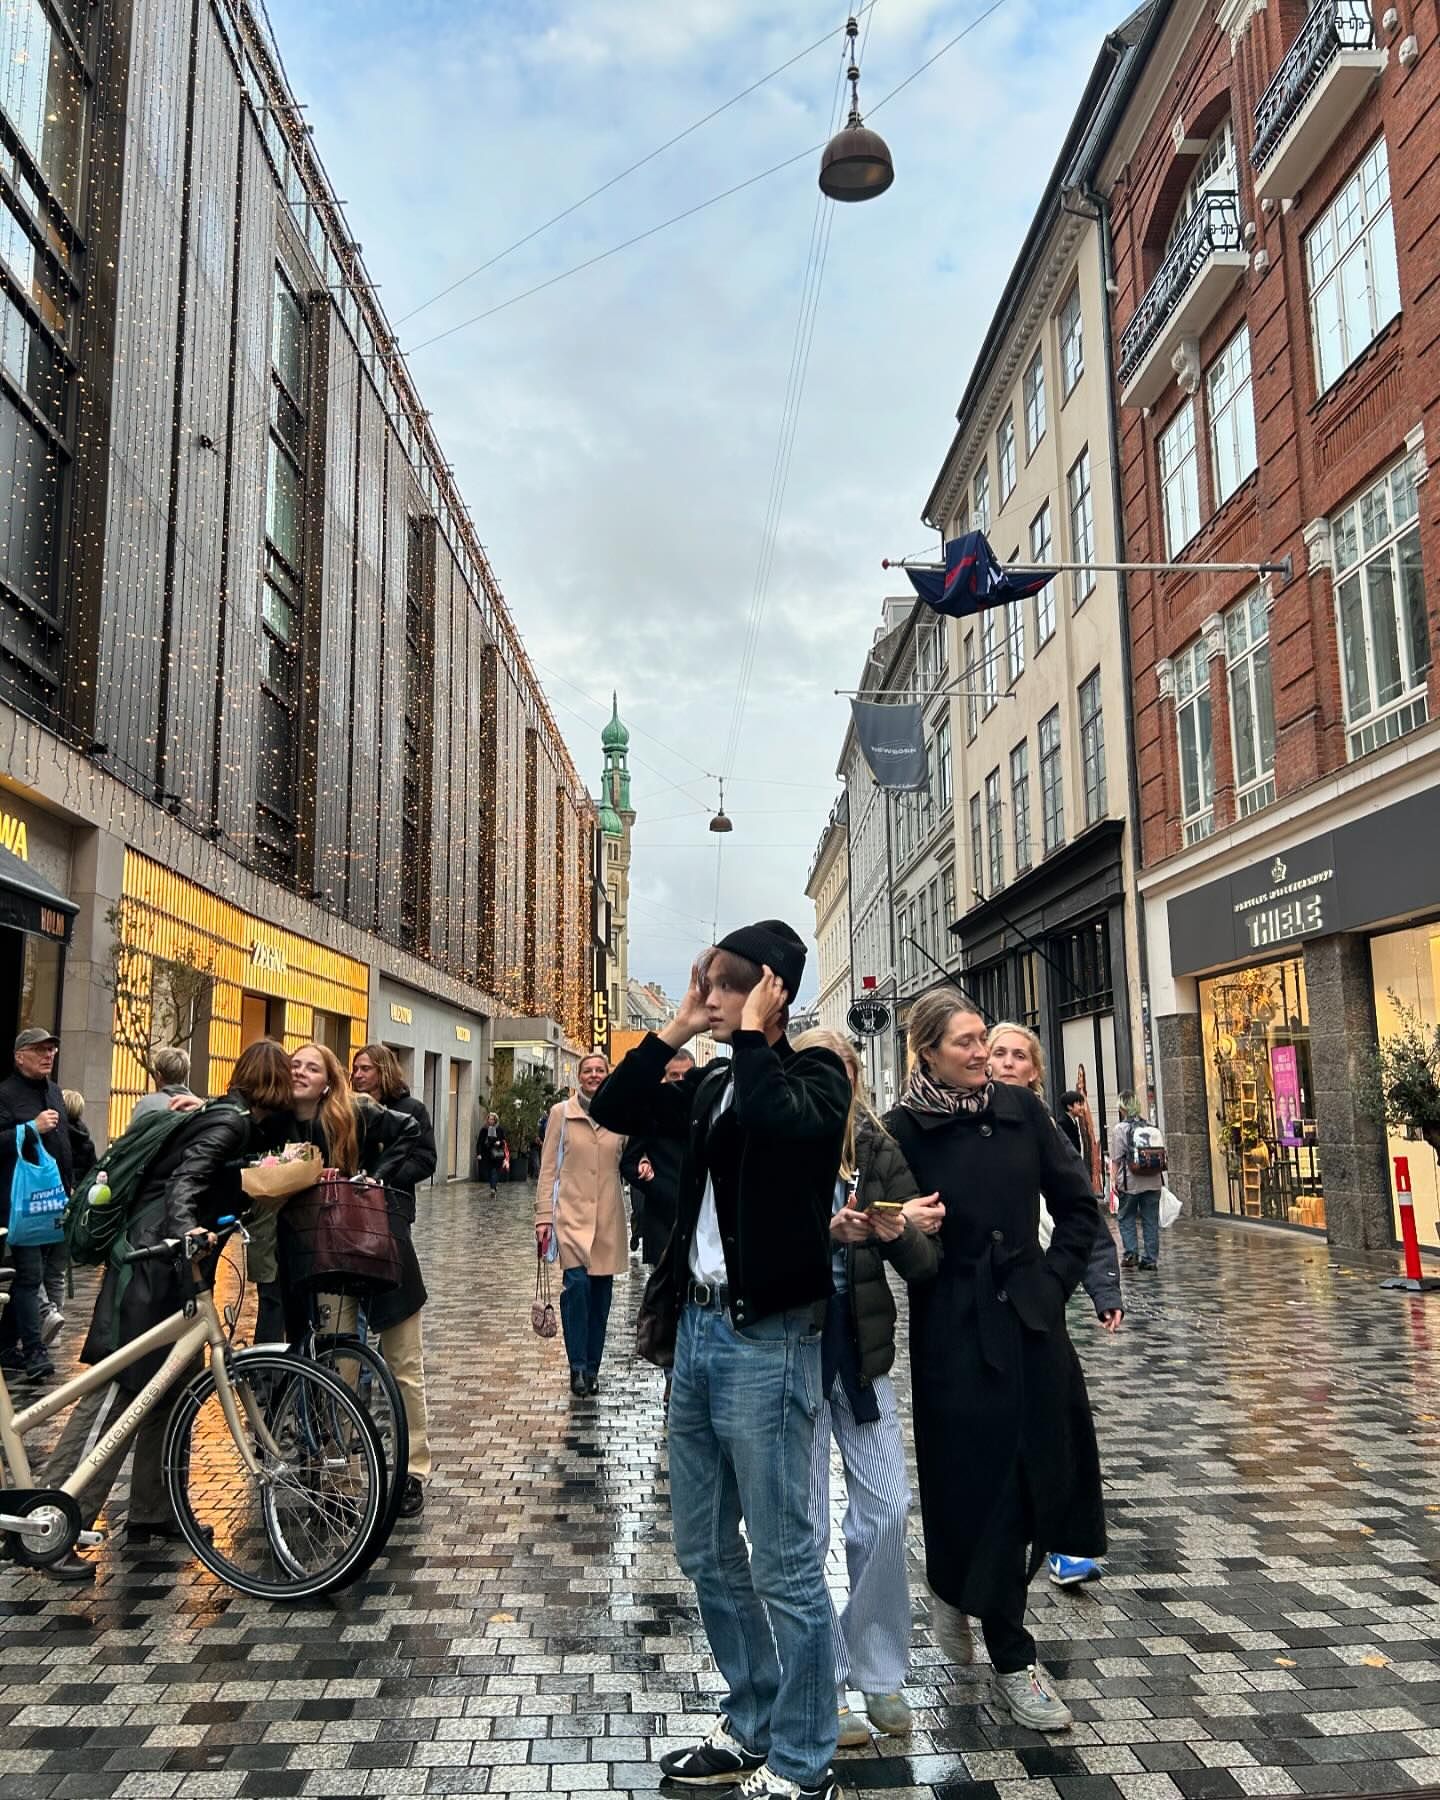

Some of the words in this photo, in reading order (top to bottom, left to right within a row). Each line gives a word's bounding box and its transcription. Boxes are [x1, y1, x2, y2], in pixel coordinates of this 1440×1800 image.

[1246, 894, 1323, 948] THIELE
[593, 991, 608, 1045] ILLUM
[88, 1384, 161, 1467] kildemoes
